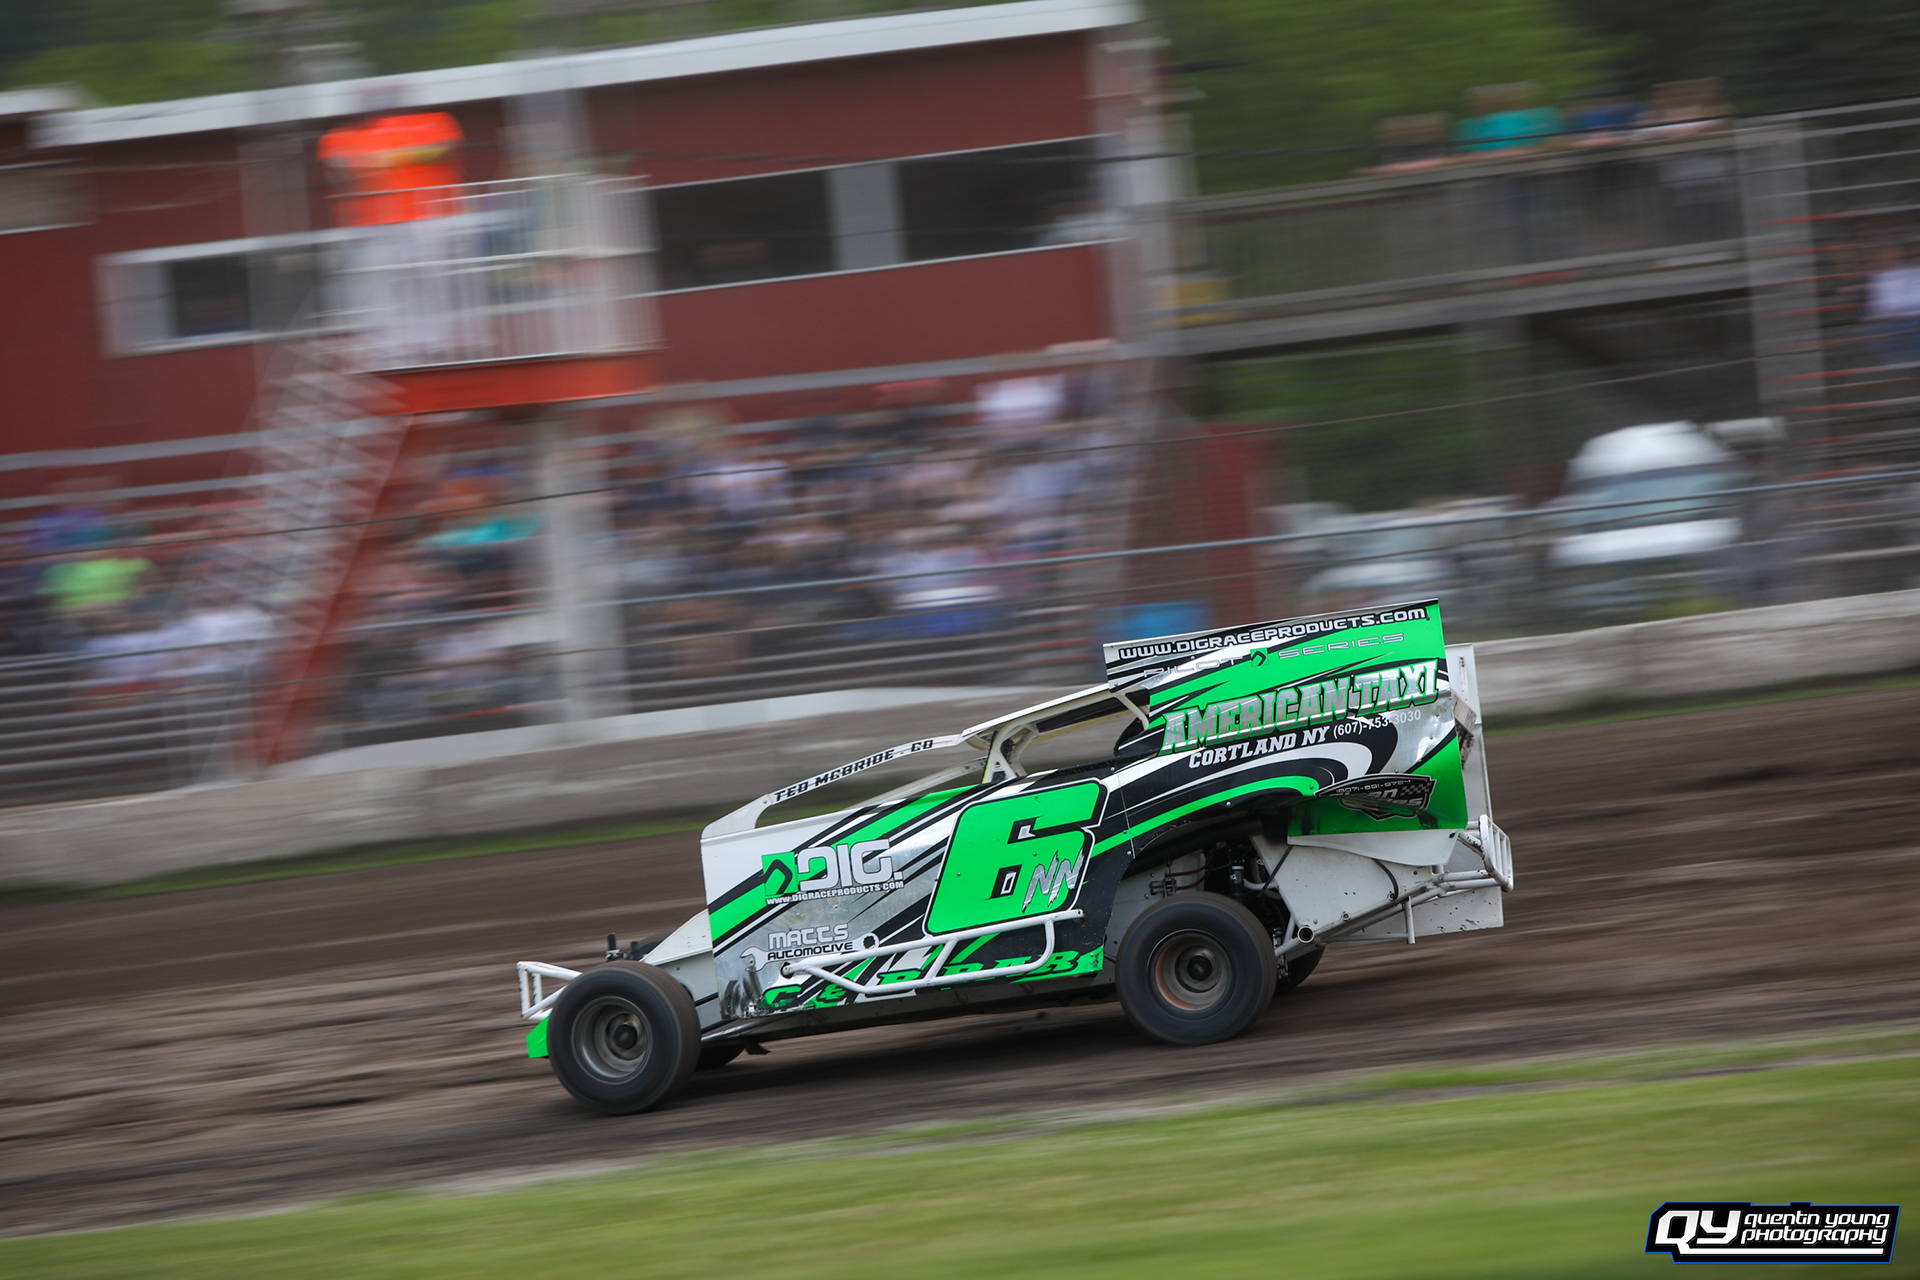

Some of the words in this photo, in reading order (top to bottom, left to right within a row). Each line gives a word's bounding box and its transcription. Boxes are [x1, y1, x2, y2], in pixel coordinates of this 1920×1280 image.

[1278, 632, 1405, 659] SERIES
[1160, 676, 1352, 756] AMERICAN
[1354, 659, 1439, 717] TAXI
[1189, 733, 1297, 769] CORTLAND
[1300, 726, 1331, 746] NY
[774, 781, 809, 802] TED
[926, 782, 1100, 934] 6
[1022, 846, 1085, 913] NN
[767, 940, 854, 961] AUTOMOTIVE
[768, 923, 850, 949] MATTS
